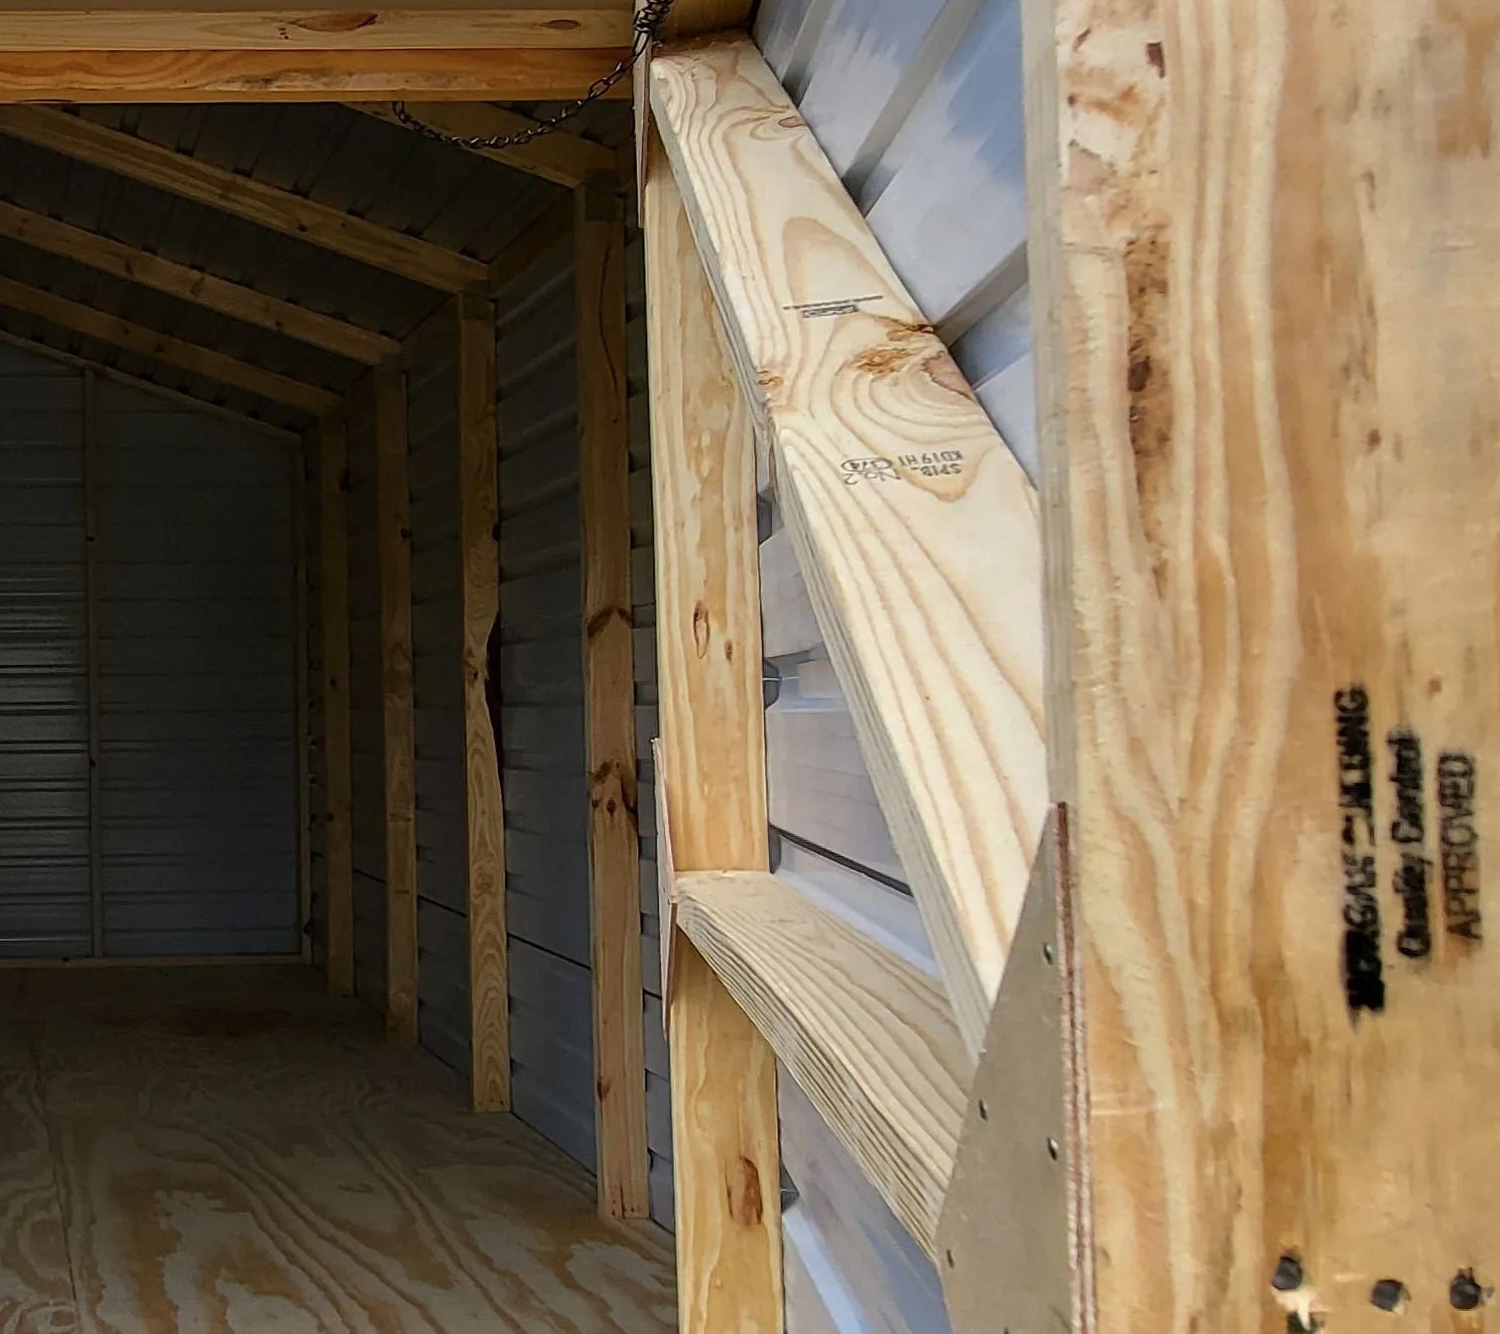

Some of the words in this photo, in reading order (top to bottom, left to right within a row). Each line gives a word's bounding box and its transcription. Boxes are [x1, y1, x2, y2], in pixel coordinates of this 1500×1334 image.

[1386, 731, 1424, 844] Control
[1437, 753, 1482, 941] APPROVED
[1391, 851, 1433, 959] Quality
